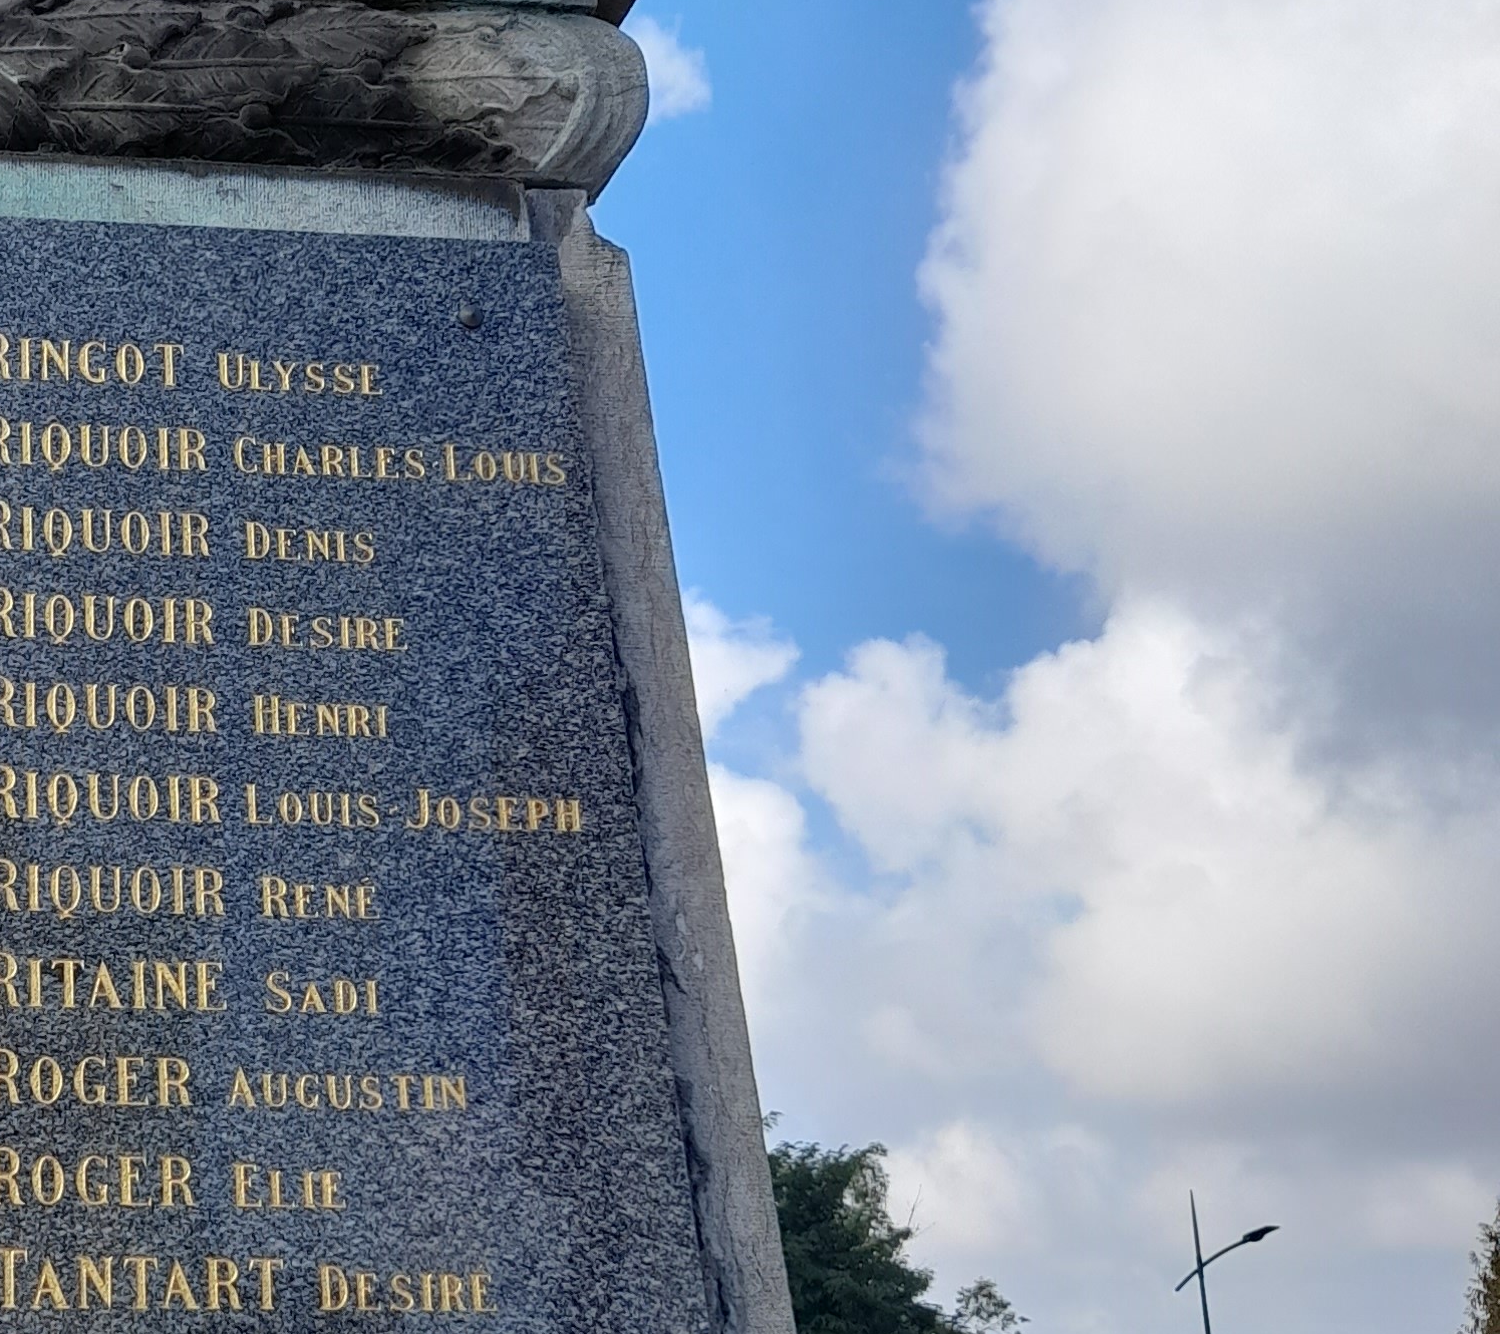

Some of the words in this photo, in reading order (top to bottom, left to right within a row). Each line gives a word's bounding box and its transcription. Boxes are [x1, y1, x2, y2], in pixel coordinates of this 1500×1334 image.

[218, 352, 383, 397] ULYSSE
[246, 520, 376, 564] DENIS
[254, 695, 389, 738] HENRI
[261, 875, 381, 921] RENÉ
[265, 971, 380, 1016] SADI
[229, 1066, 469, 1111] AUGUSTIN
[234, 1163, 348, 1210] ELIE
